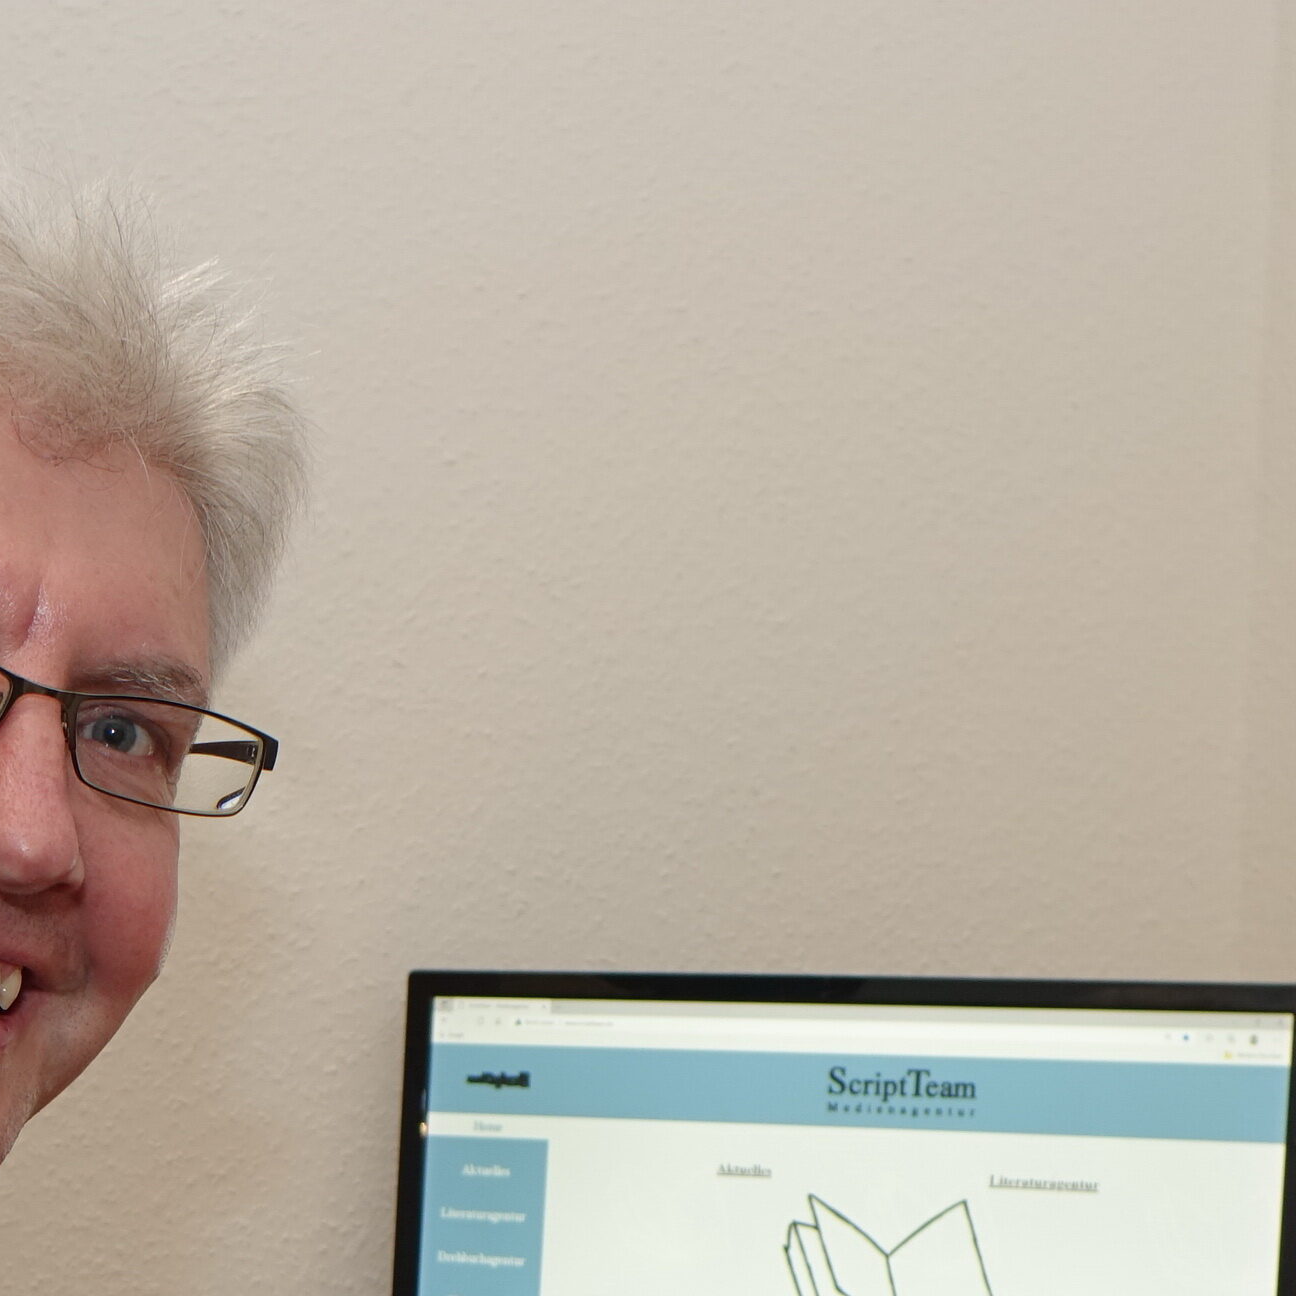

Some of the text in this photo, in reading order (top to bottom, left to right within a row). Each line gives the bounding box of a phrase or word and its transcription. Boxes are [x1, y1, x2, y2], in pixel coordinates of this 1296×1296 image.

[828, 1065, 976, 1102] ScriptTeam
[716, 1162, 772, 1178] Aktuelles
[989, 1173, 1099, 1193] Literaturagentur
